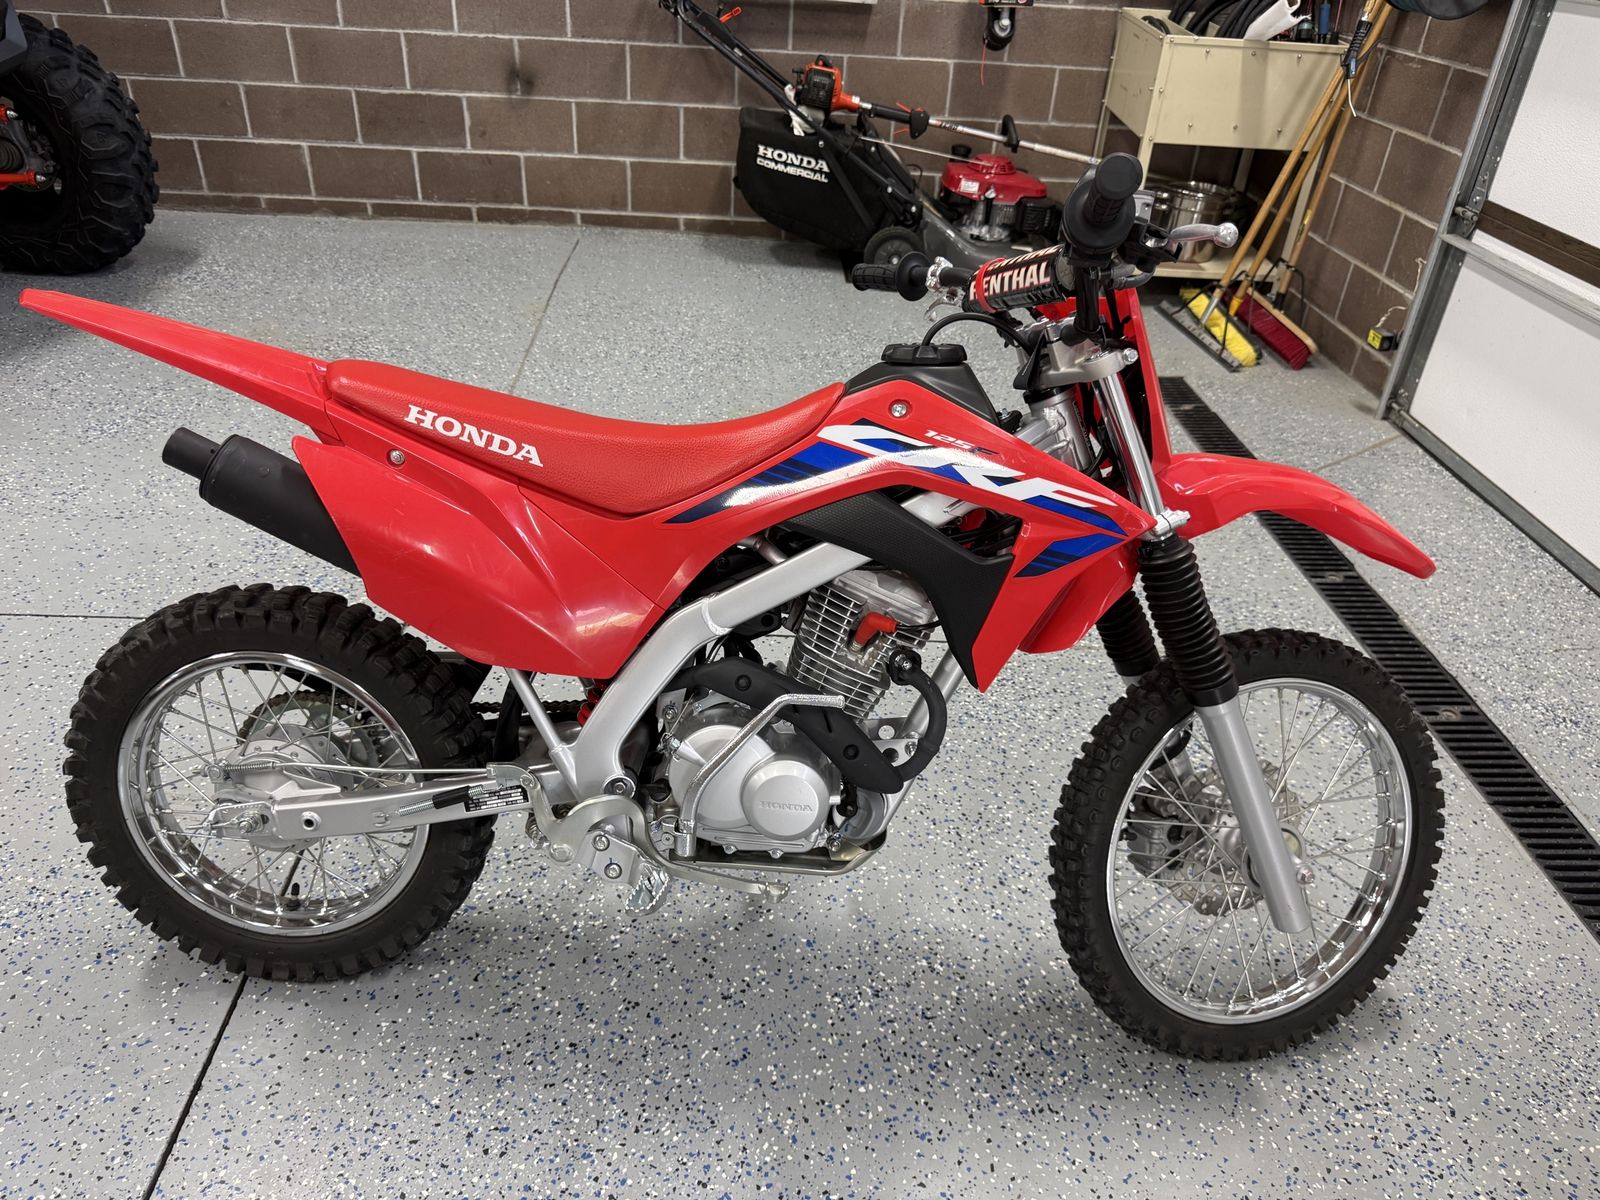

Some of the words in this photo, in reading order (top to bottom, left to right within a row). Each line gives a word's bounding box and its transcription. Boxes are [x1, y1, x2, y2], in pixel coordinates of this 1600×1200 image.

[756, 157, 829, 183] COMMERCIAL
[757, 144, 830, 173] HONDA
[404, 404, 544, 468] HONDA
[760, 800, 813, 812] HONDA
